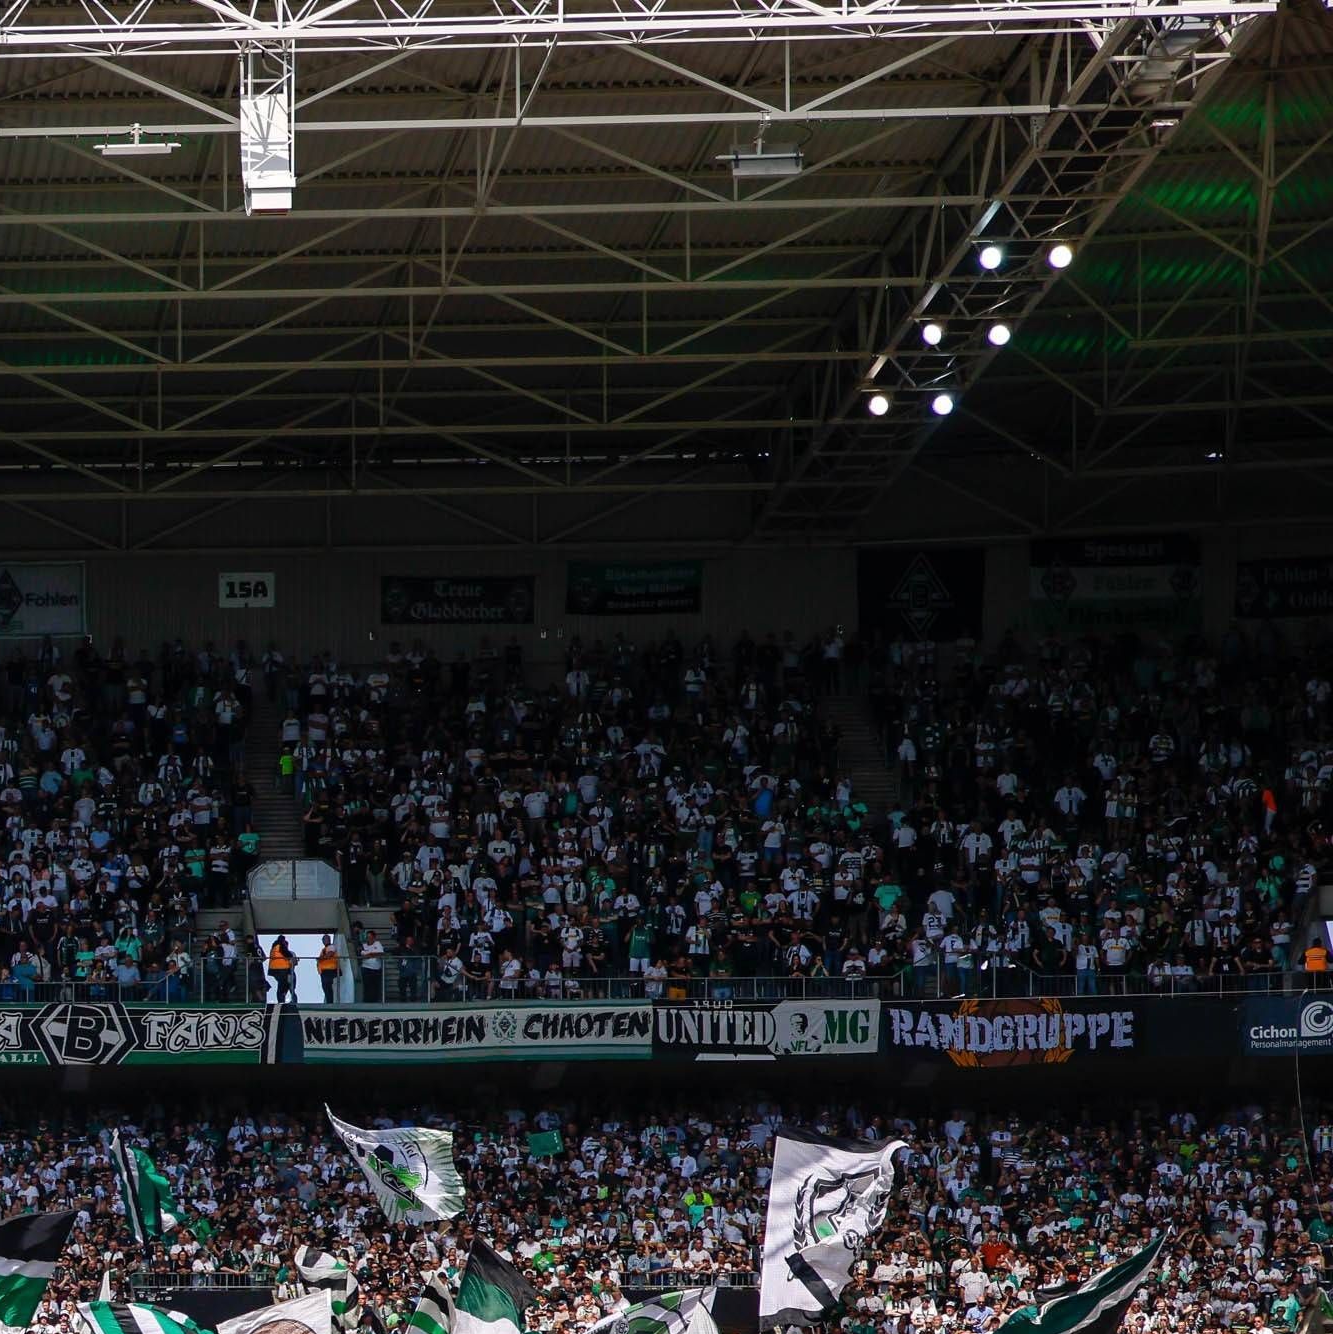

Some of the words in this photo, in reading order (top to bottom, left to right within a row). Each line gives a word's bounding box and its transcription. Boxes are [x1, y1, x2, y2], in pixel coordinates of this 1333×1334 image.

[24, 592, 78, 607] Fohlen
[225, 581, 268, 598] 15A
[140, 1008, 266, 1053] FANS
[302, 1014, 487, 1045] NIEDERRHEIN
[520, 1011, 652, 1042] CHAOTEN
[655, 1008, 777, 1048] UNITED
[823, 1009, 870, 1045] MG
[887, 1009, 1134, 1053] RANDGRUPPE
[1250, 1024, 1297, 1039] Cichon
[1250, 1037, 1332, 1050] Personalmanagement
